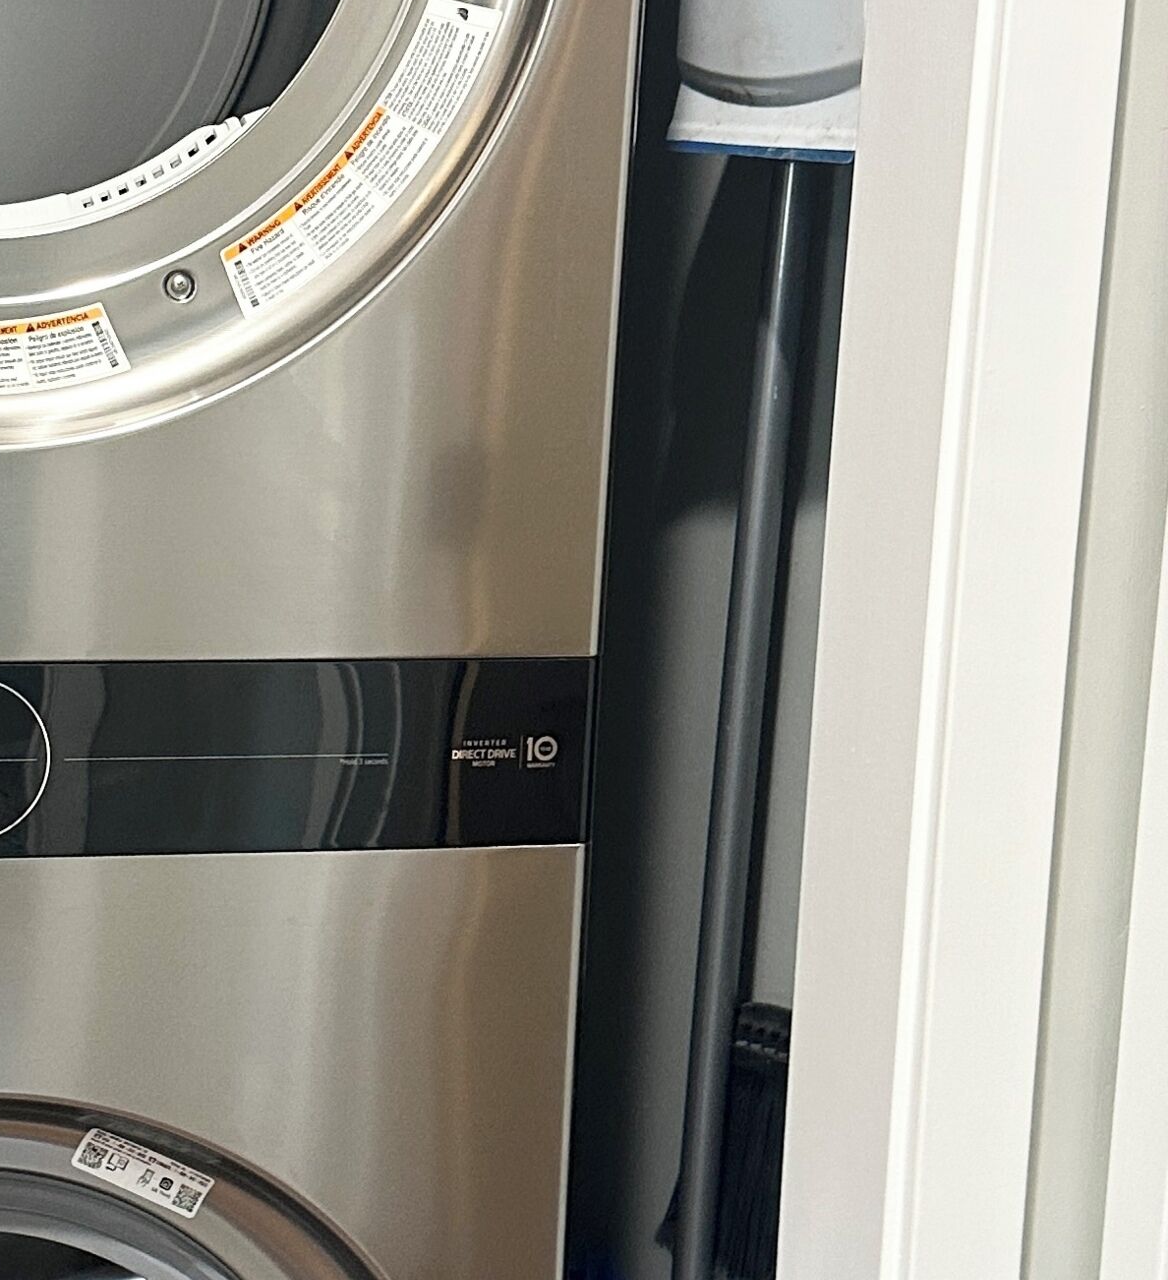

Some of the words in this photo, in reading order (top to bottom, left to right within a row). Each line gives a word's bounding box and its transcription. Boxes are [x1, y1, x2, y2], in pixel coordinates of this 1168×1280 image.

[246, 219, 281, 246] WARNING
[36, 312, 89, 330] ADVERTENCIA
[451, 749, 486, 760] DIRECT
[487, 748, 517, 759] DRIVE
[526, 735, 558, 762] 10
